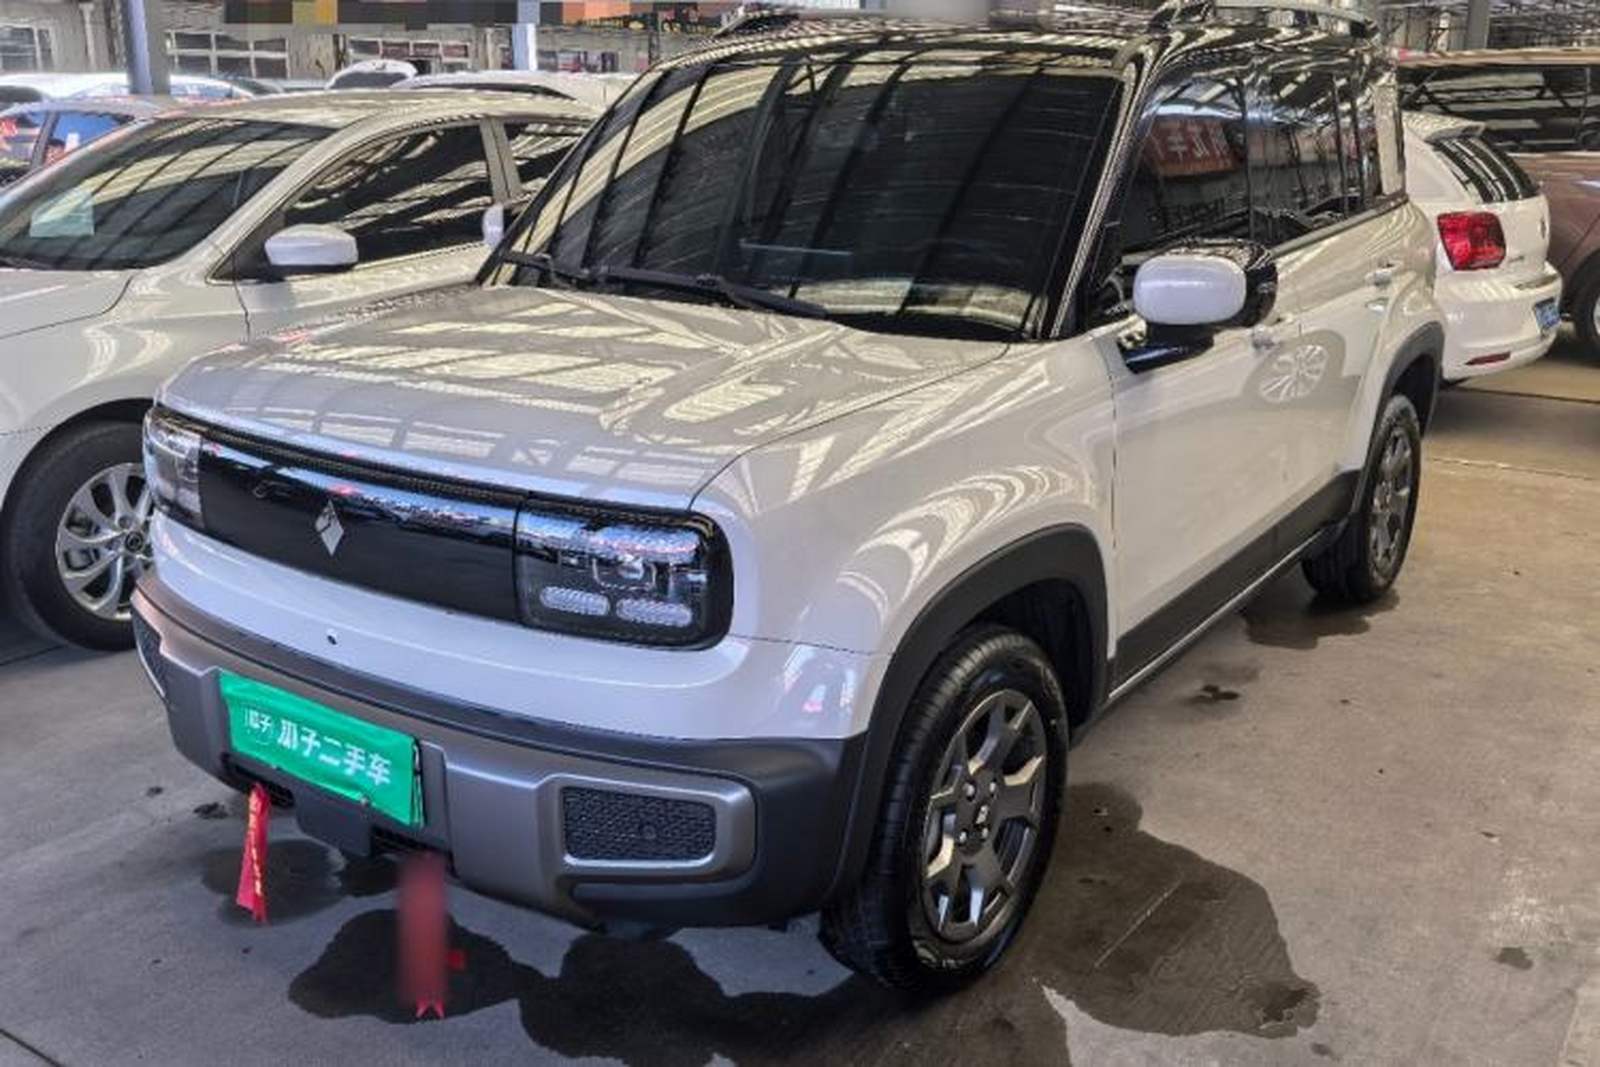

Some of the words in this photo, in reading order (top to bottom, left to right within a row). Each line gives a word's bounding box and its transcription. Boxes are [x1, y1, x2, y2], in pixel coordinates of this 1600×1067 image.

[276, 718, 392, 786] 瓜子二手车
